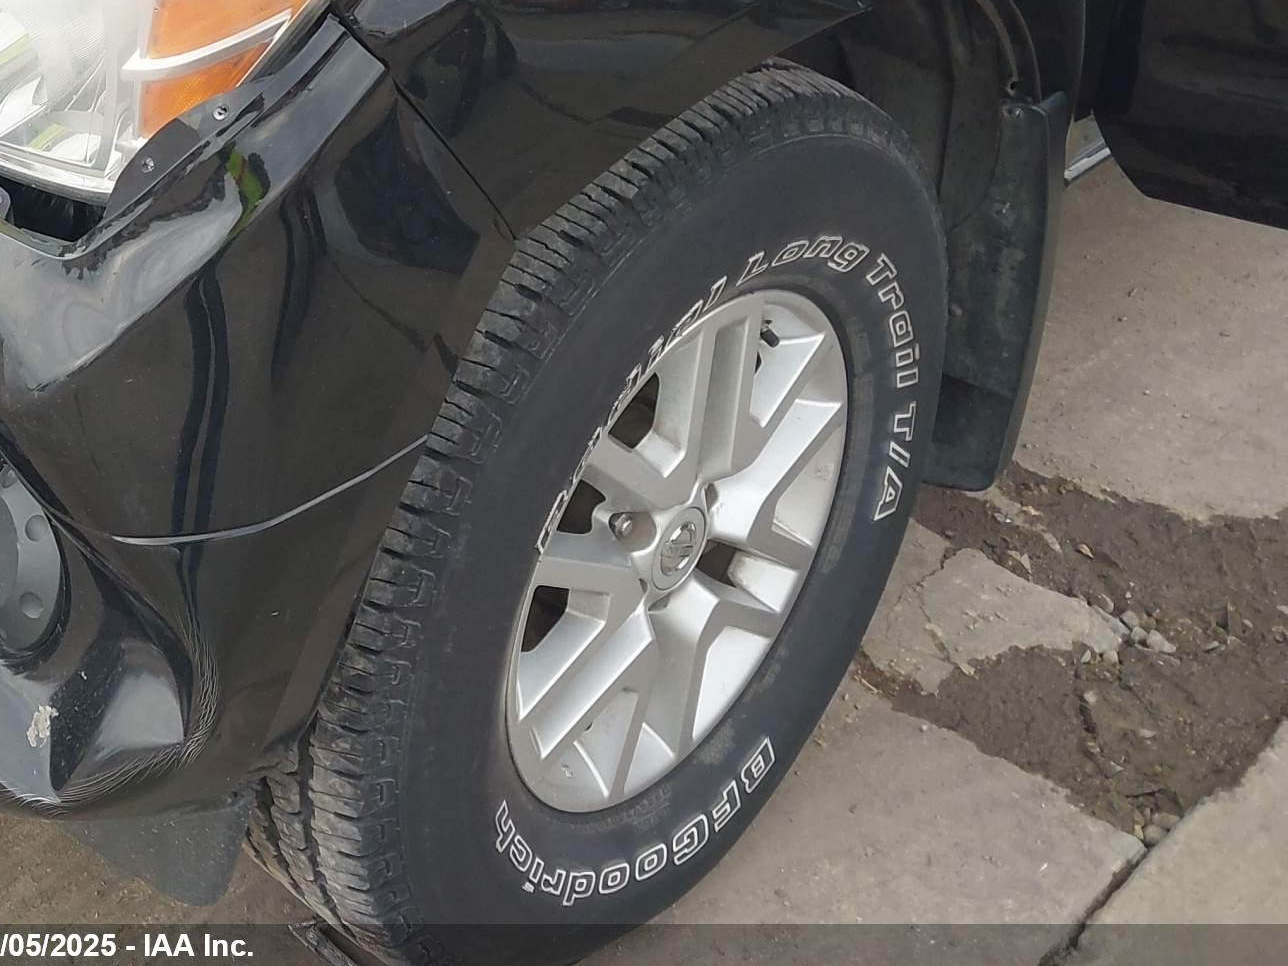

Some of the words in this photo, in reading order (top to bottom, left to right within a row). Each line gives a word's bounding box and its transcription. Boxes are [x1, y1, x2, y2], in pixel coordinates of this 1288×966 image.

[736, 235, 870, 287] Long
[866, 253, 920, 388] Trail
[873, 403, 917, 522] T/A
[494, 737, 776, 907] BFGoodrich
